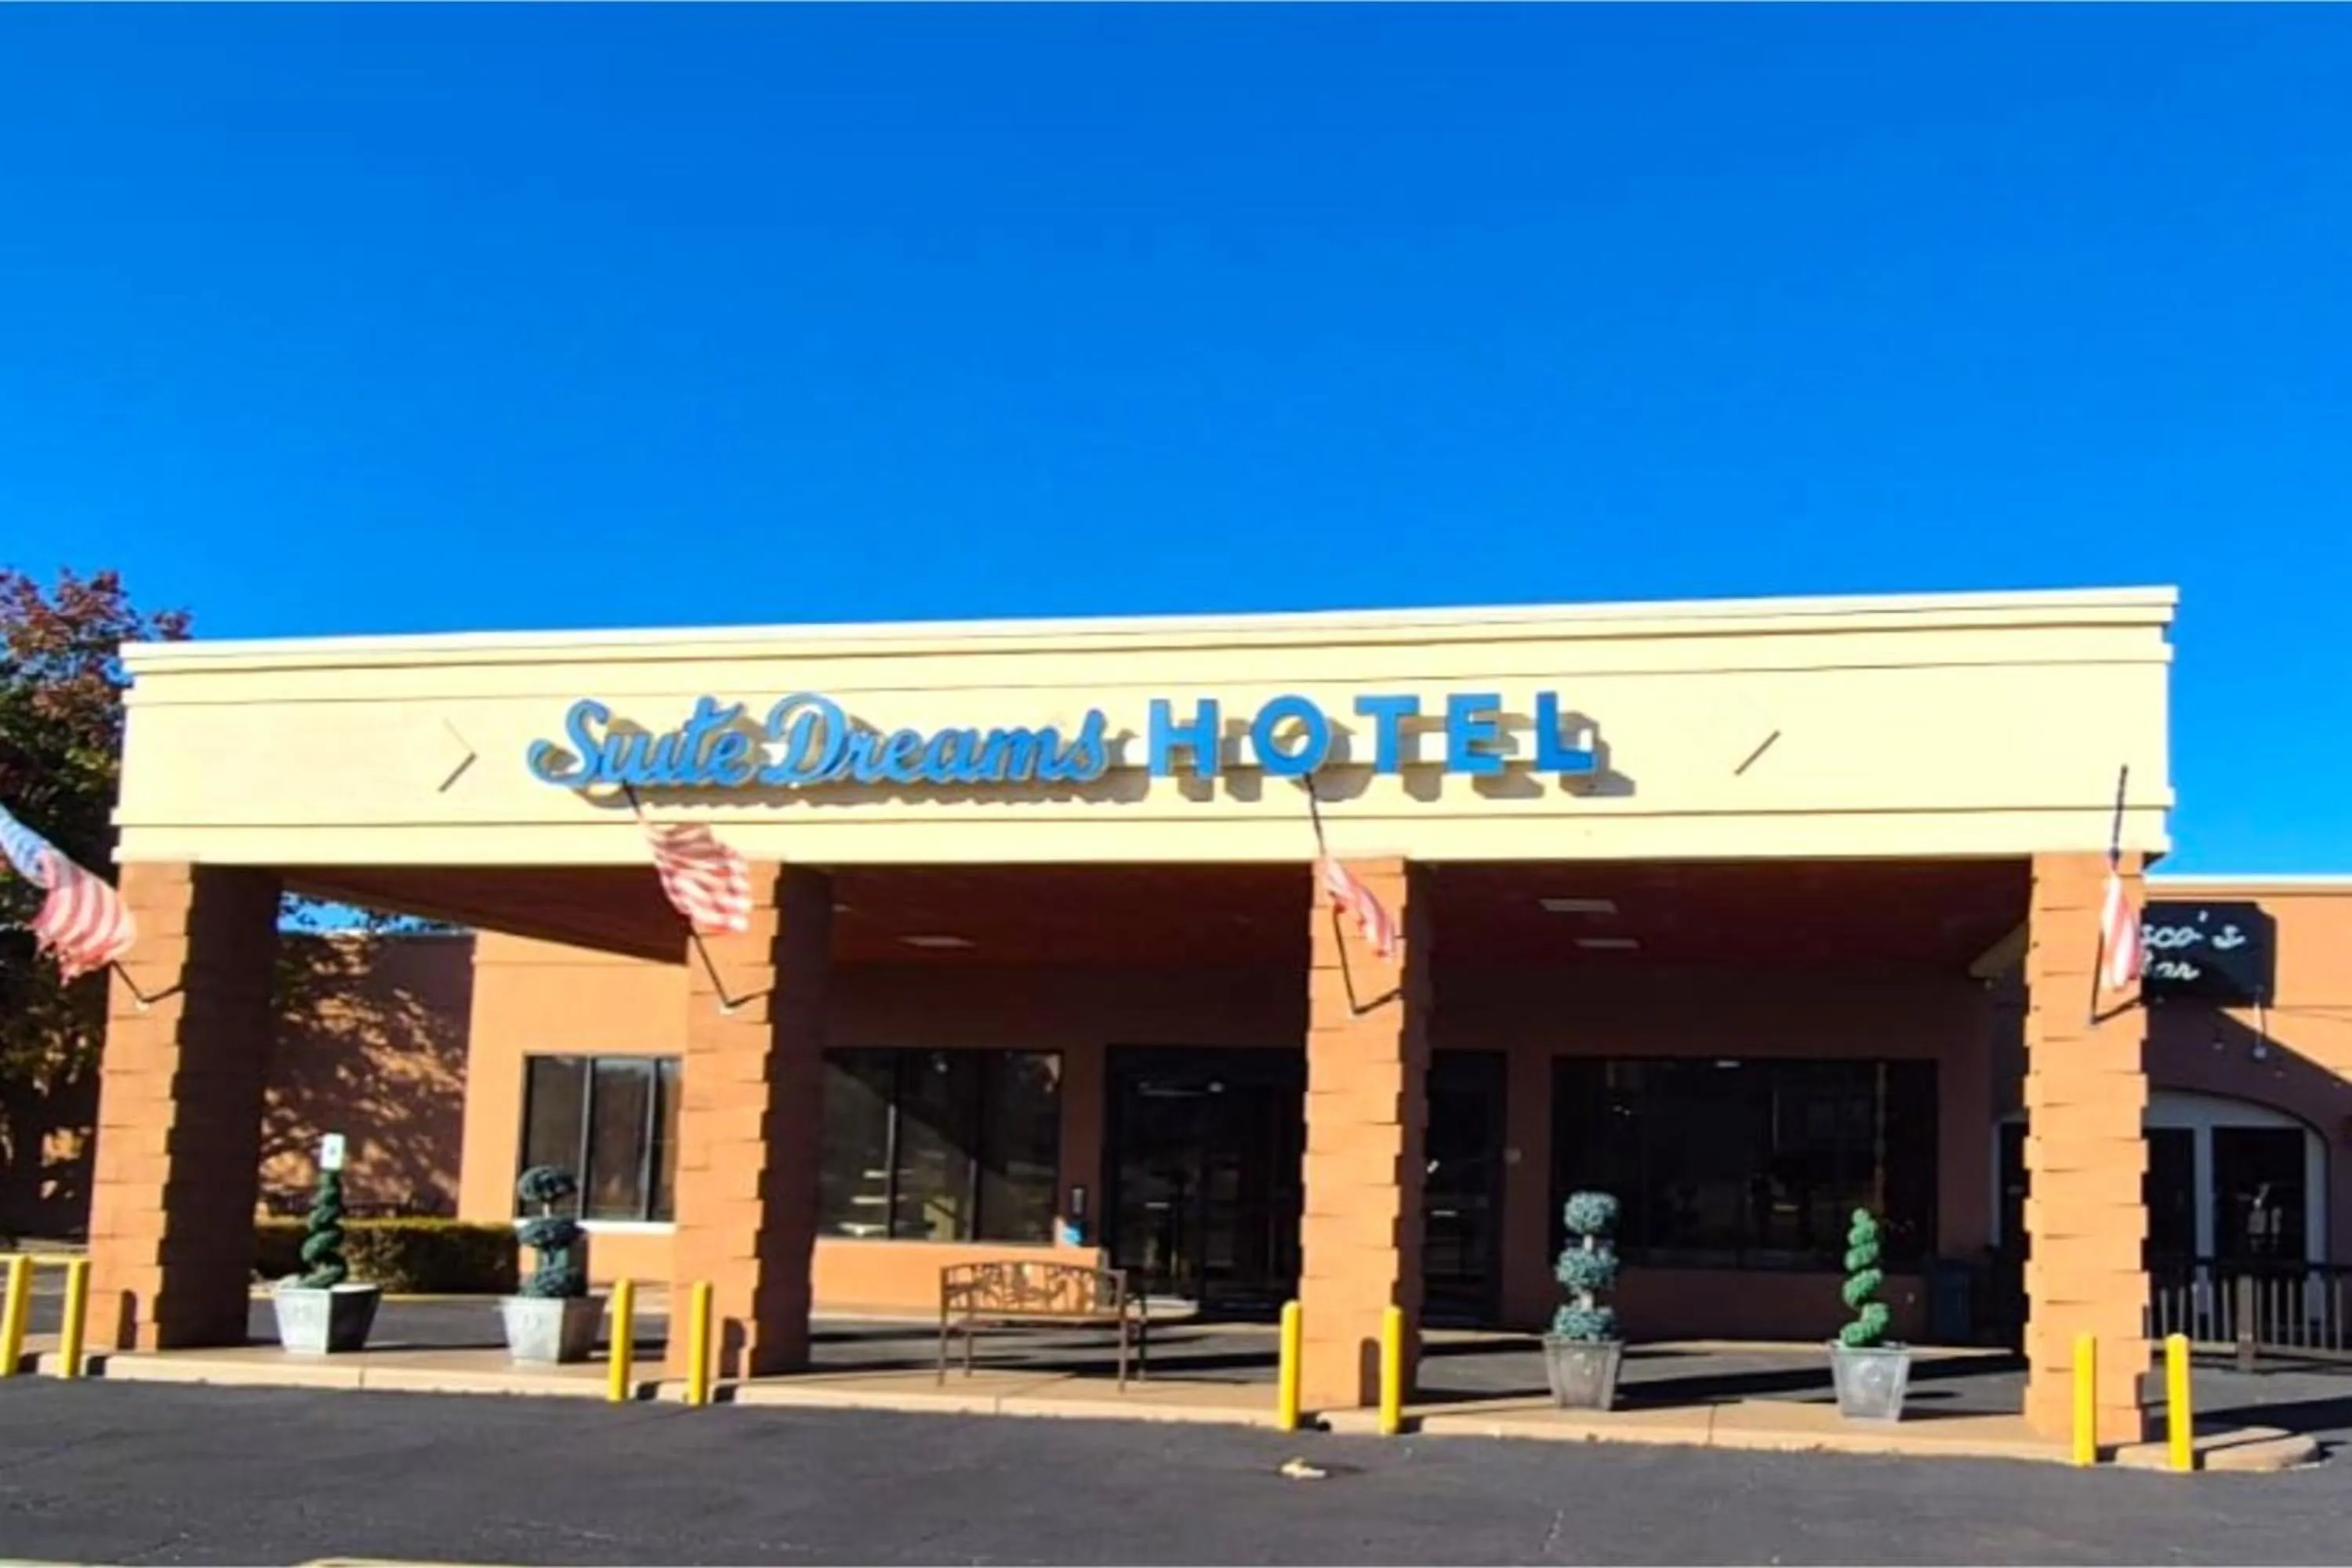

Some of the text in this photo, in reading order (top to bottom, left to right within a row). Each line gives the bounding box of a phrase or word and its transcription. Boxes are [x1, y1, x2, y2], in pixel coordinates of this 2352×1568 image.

[527, 691, 1597, 786] Suite Dreams HOTEL
